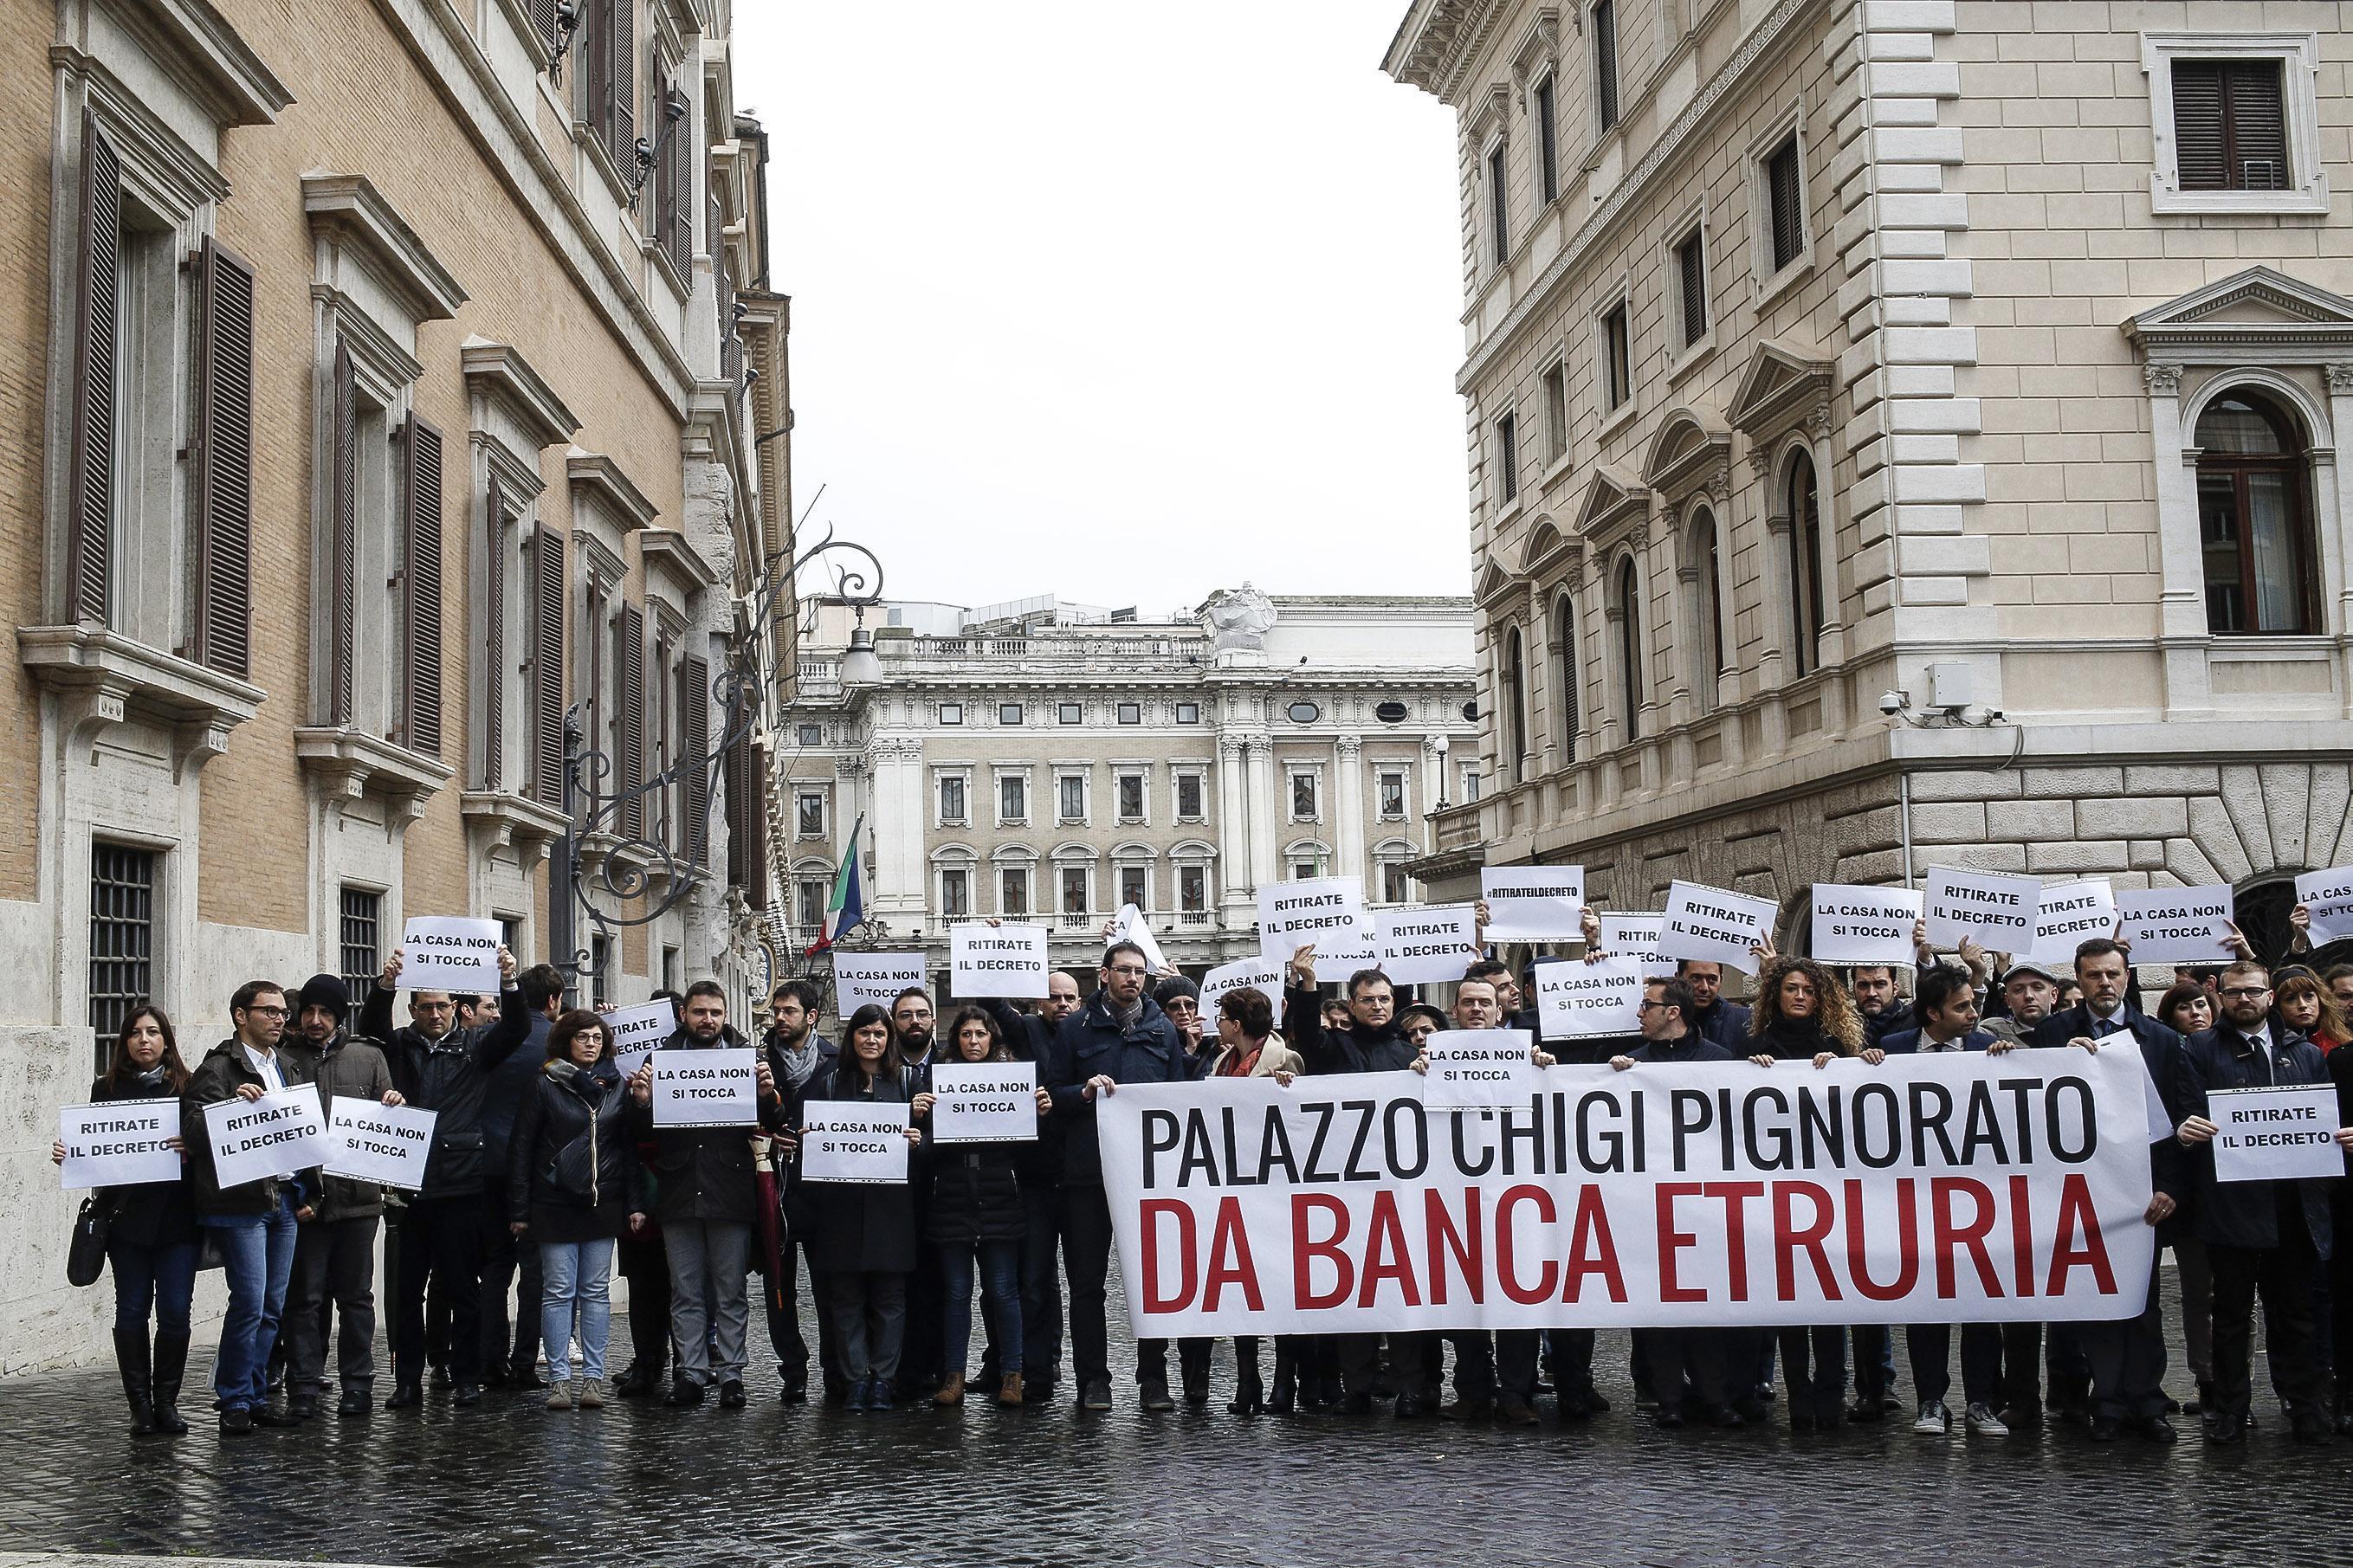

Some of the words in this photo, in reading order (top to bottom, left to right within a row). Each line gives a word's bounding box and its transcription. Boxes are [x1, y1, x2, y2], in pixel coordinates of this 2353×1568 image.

[1487, 887, 1577, 898] #RITIRATEILDECRETO
[1945, 886, 2019, 905] RITIRATE
[2302, 892, 2319, 902] LA
[2324, 887, 2351, 898] CAS
[1275, 894, 1342, 911] RITIRATE
[2037, 897, 2096, 915] TIRATE
[1685, 902, 1755, 926] RITIRATE
[1819, 905, 1836, 914] LA
[1840, 907, 1878, 917] CASA
[1884, 908, 1915, 919] NON
[1934, 907, 1946, 918] IL
[1952, 909, 2026, 926] DECRETO
[2124, 911, 2143, 920] LA
[2148, 908, 2188, 920] CASA
[2193, 906, 2225, 917] NON
[2319, 907, 2333, 917] SI
[1268, 923, 1281, 933] IL
[1285, 915, 1353, 931] DECRETO
[1393, 923, 1459, 937] RITIRATE
[2037, 917, 2110, 937] DECRETO
[1619, 931, 1661, 941] RITIR
[1671, 921, 1684, 932] IL
[1690, 925, 1761, 946] DECRETO
[1833, 926, 1846, 935] SI
[1851, 926, 1900, 938] TOCCA
[2141, 930, 2154, 939] SI
[2159, 926, 2211, 939] TOCCA
[405, 935, 421, 944] LA
[426, 936, 462, 946] CASA
[467, 939, 495, 948] NON
[969, 940, 1031, 950] RITIRATE
[1386, 948, 1398, 958] IL
[1403, 943, 1471, 957] DECRETO
[1627, 952, 1678, 962] ECRE
[417, 954, 429, 964] SI
[435, 955, 481, 966] TOCCA
[960, 961, 972, 970] IL
[978, 960, 1040, 971] DECRETO
[857, 971, 888, 980] CASA
[1205, 983, 1217, 992] LA
[1221, 977, 1251, 988] CASA
[1255, 973, 1277, 984] NON
[1542, 983, 1560, 992] LA
[1564, 979, 1601, 990] CASA
[1606, 976, 1635, 987] NON
[866, 988, 904, 998] TOCC
[1214, 998, 1222, 1009] S
[1559, 1001, 1571, 1010] SI
[1576, 997, 1624, 1009] TOCCA
[610, 1018, 658, 1036] TIRATE
[617, 1036, 669, 1055] ECRETO
[1430, 1051, 1446, 1060] LA
[1451, 1050, 1489, 1060] CASA
[1495, 1050, 1524, 1060] NON
[658, 1071, 675, 1080] LA
[680, 1069, 715, 1079] CASA
[721, 1068, 749, 1078] NON
[1445, 1071, 1457, 1081] SI
[1462, 1071, 1510, 1080] TOCCA
[672, 1090, 684, 1099] SI
[689, 1088, 735, 1098] TOCCA
[939, 1084, 955, 1093] LA
[960, 1084, 996, 1093] CASA
[1000, 1083, 1029, 1092] NON
[953, 1104, 965, 1113] SI
[970, 1102, 1016, 1112] TOCCA
[227, 1106, 304, 1132] RITIRATE
[2232, 1107, 2316, 1123] RITIRATE
[81, 1119, 158, 1134] RITIRATE
[336, 1117, 352, 1127] LA
[354, 1120, 391, 1135] CASA
[396, 1127, 425, 1141] NON
[809, 1122, 825, 1133] LA
[831, 1123, 867, 1132] CASA
[873, 1124, 902, 1133] NON
[1142, 1098, 1428, 1189] PALAZZO
[1448, 1091, 1645, 1177] CHIGI
[1671, 1076, 2097, 1171] PIGNORATO
[222, 1145, 236, 1156] IL
[241, 1126, 316, 1151] DECRETO
[823, 1142, 834, 1152] SI
[840, 1143, 887, 1152] TOCCA
[2223, 1137, 2239, 1148] IL
[2245, 1132, 2330, 1146] DECRETO
[71, 1147, 85, 1158] IL
[92, 1138, 170, 1156] DECRETO
[347, 1139, 359, 1149] SI
[365, 1141, 406, 1158] TOCCA
[1140, 1197, 1264, 1313] DA
[1291, 1184, 1628, 1310] BANCA
[1659, 1173, 2119, 1302] ETRURIA
